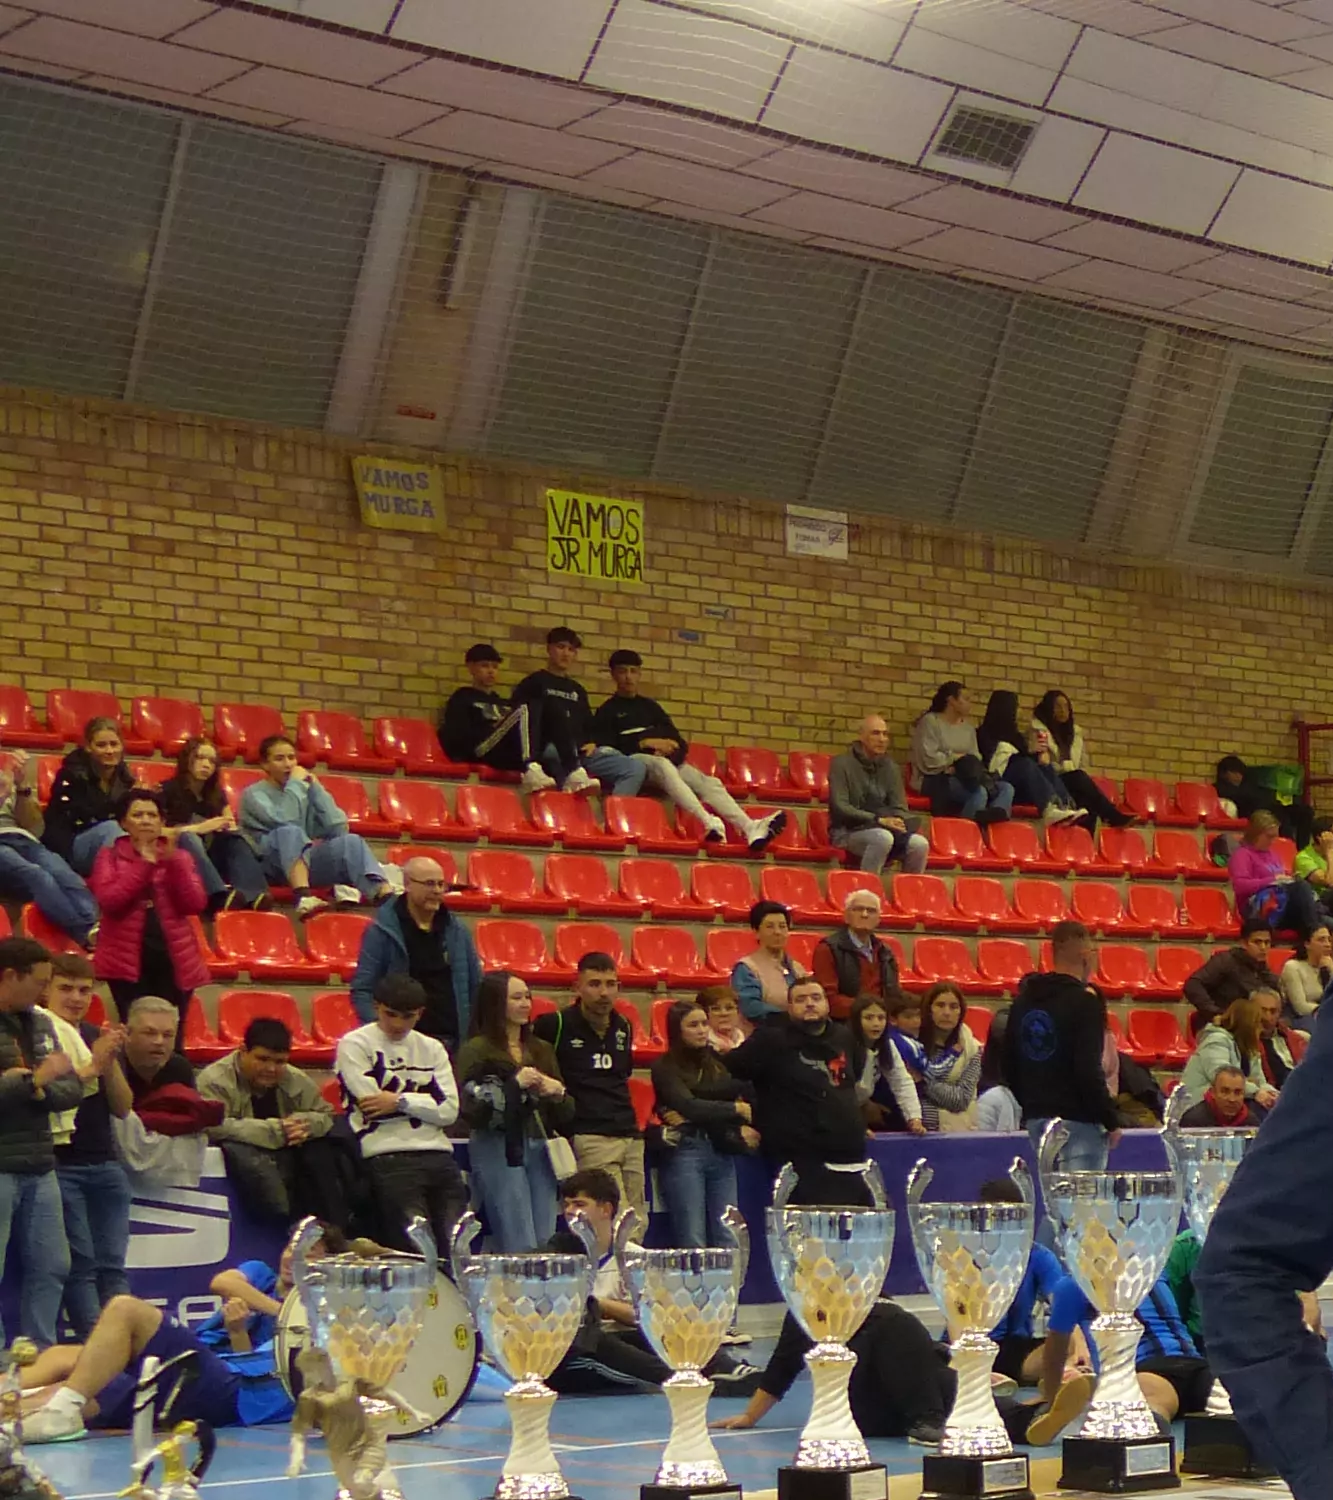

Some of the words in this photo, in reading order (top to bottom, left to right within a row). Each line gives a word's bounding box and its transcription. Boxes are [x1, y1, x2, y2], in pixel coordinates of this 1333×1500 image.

[361, 465, 429, 492] VAMOS
[364, 491, 437, 519] MURGA
[549, 496, 641, 545] VAMOS
[588, 541, 643, 581] MURGA
[592, 1053, 613, 1069] 10
